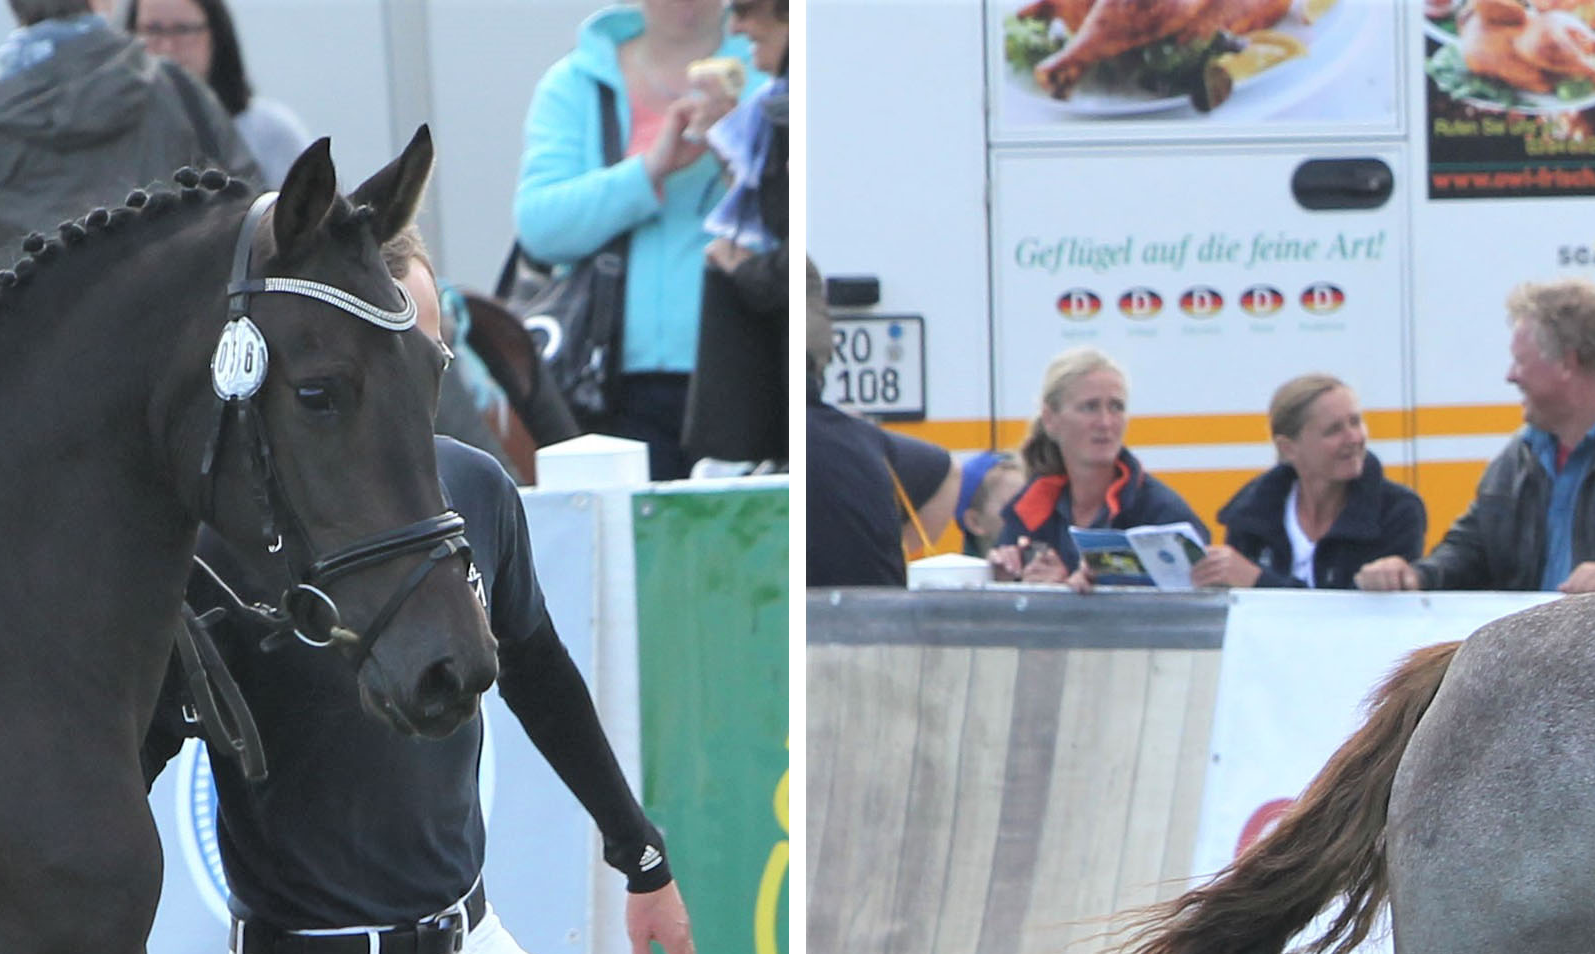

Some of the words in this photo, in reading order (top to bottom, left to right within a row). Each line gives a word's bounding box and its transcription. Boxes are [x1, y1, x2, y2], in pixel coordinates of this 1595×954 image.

[1014, 236, 1134, 274] Geflügel
[1142, 233, 1190, 271] auf
[1196, 232, 1240, 264] die
[1244, 230, 1318, 269] feine
[1326, 229, 1387, 262] Art!
[836, 366, 900, 404] 108
